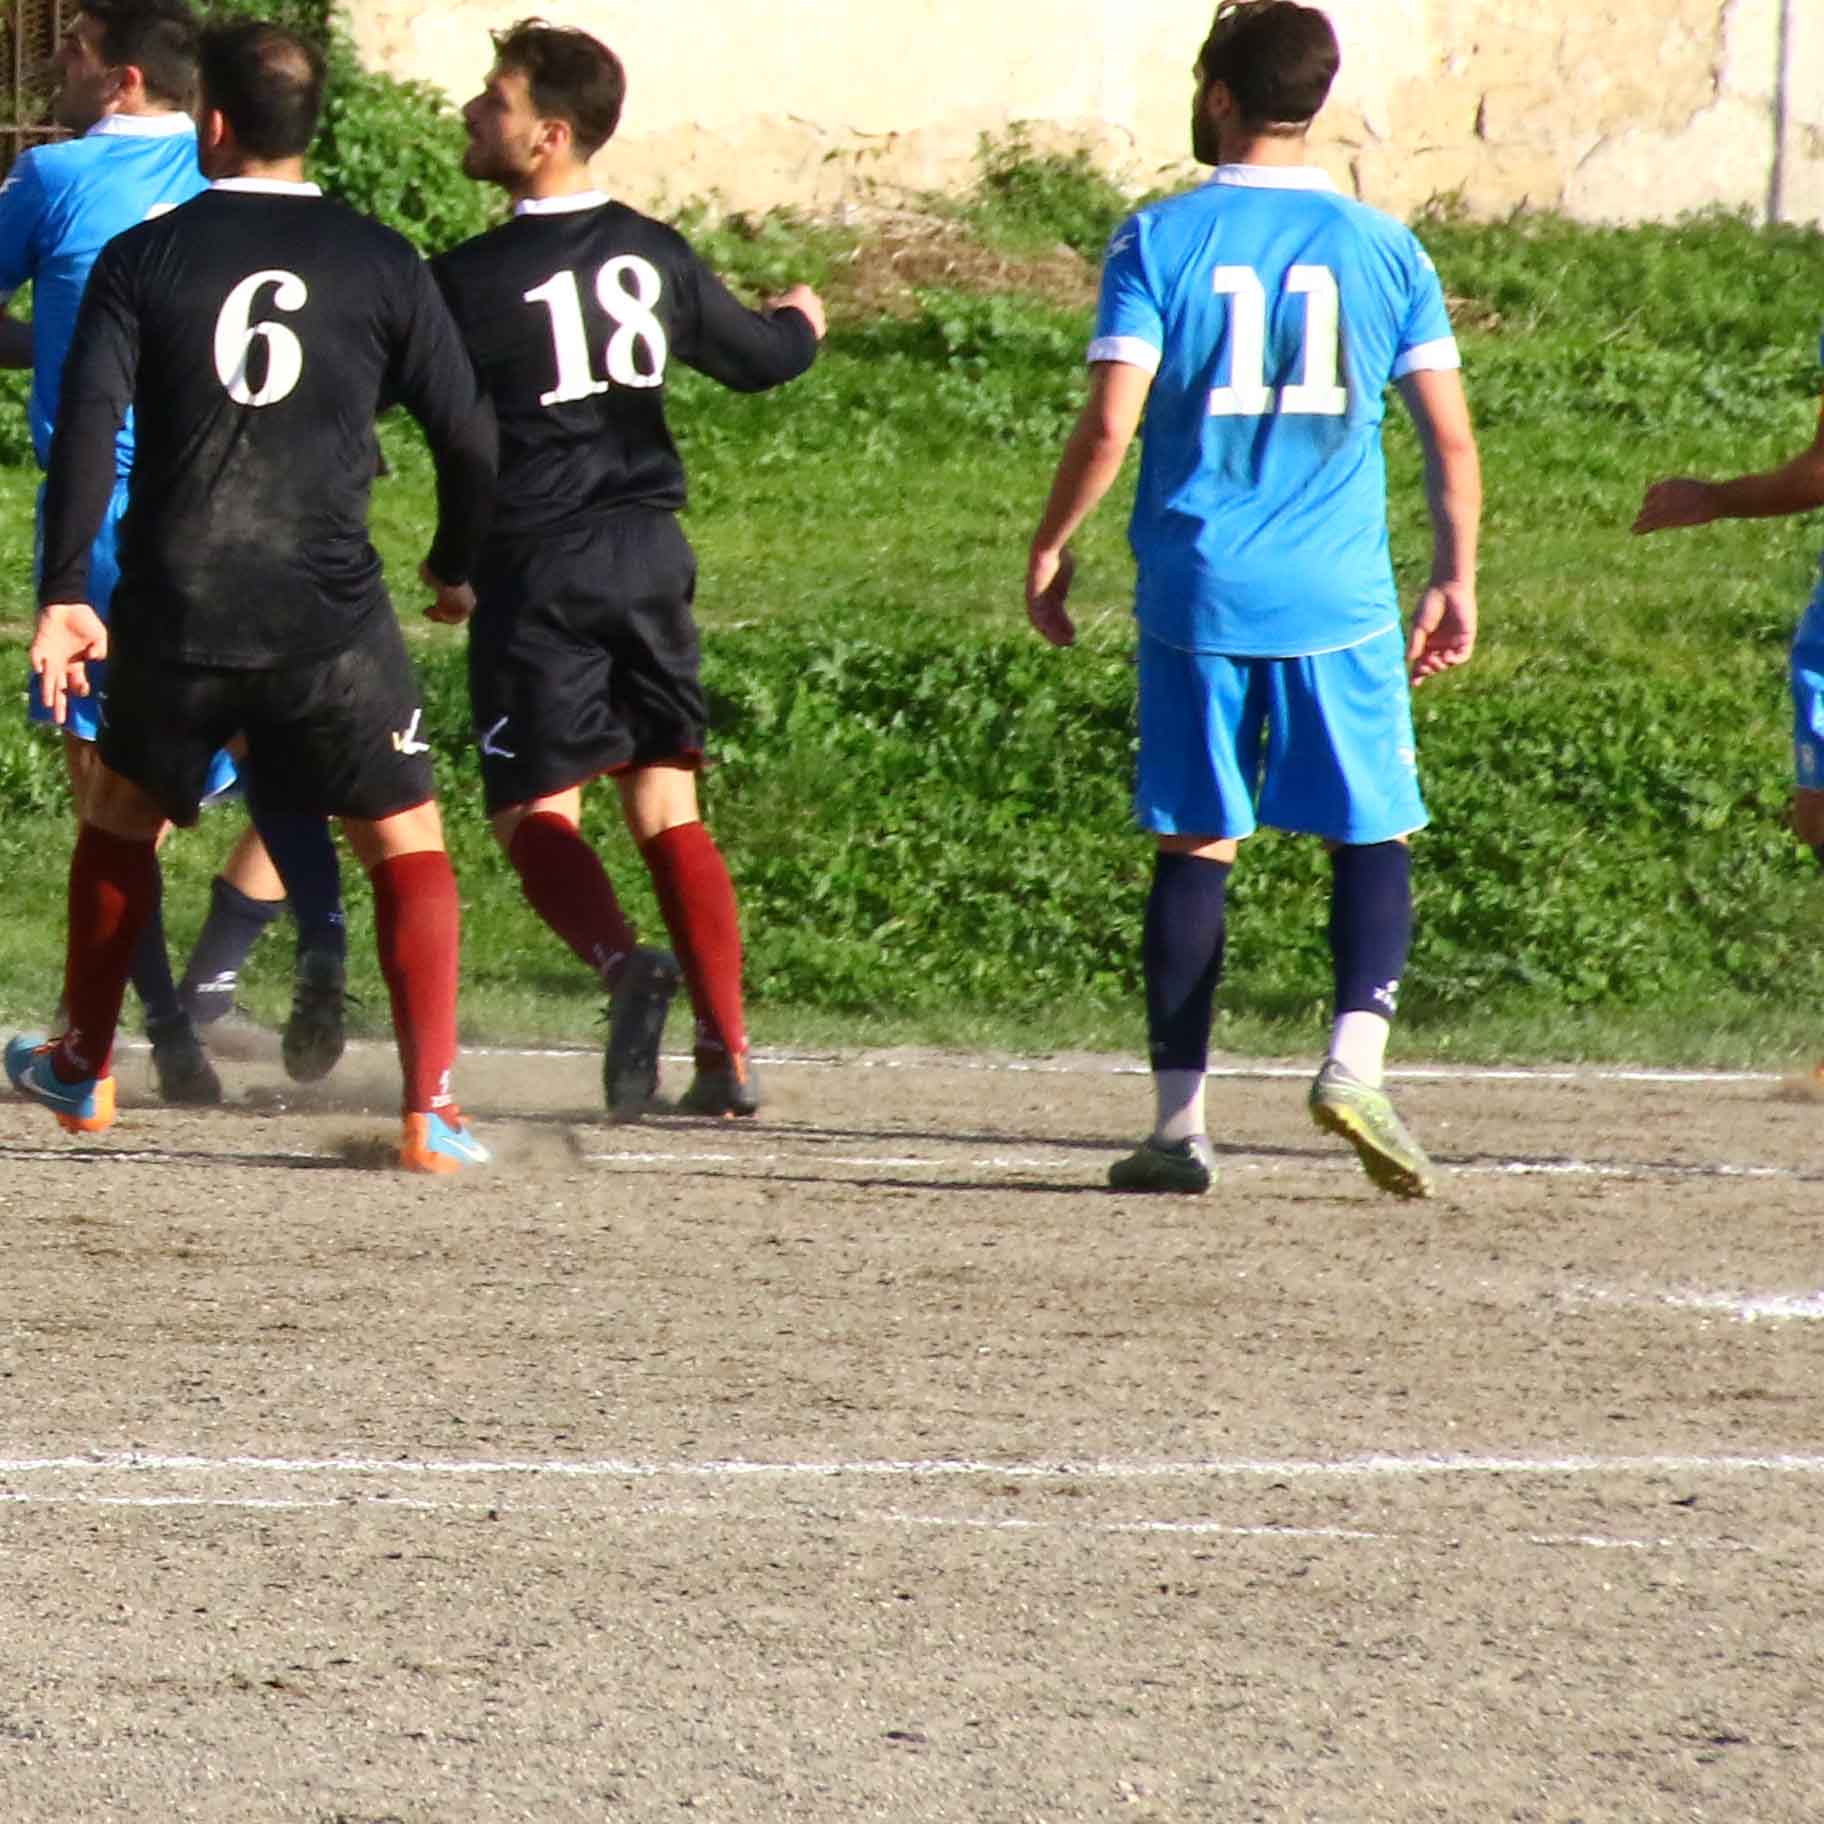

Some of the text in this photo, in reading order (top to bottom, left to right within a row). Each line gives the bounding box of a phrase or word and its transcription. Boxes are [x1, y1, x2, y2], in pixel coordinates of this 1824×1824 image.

[213, 269, 308, 407] 6
[524, 255, 668, 407] 18
[1209, 265, 1347, 416] 11
